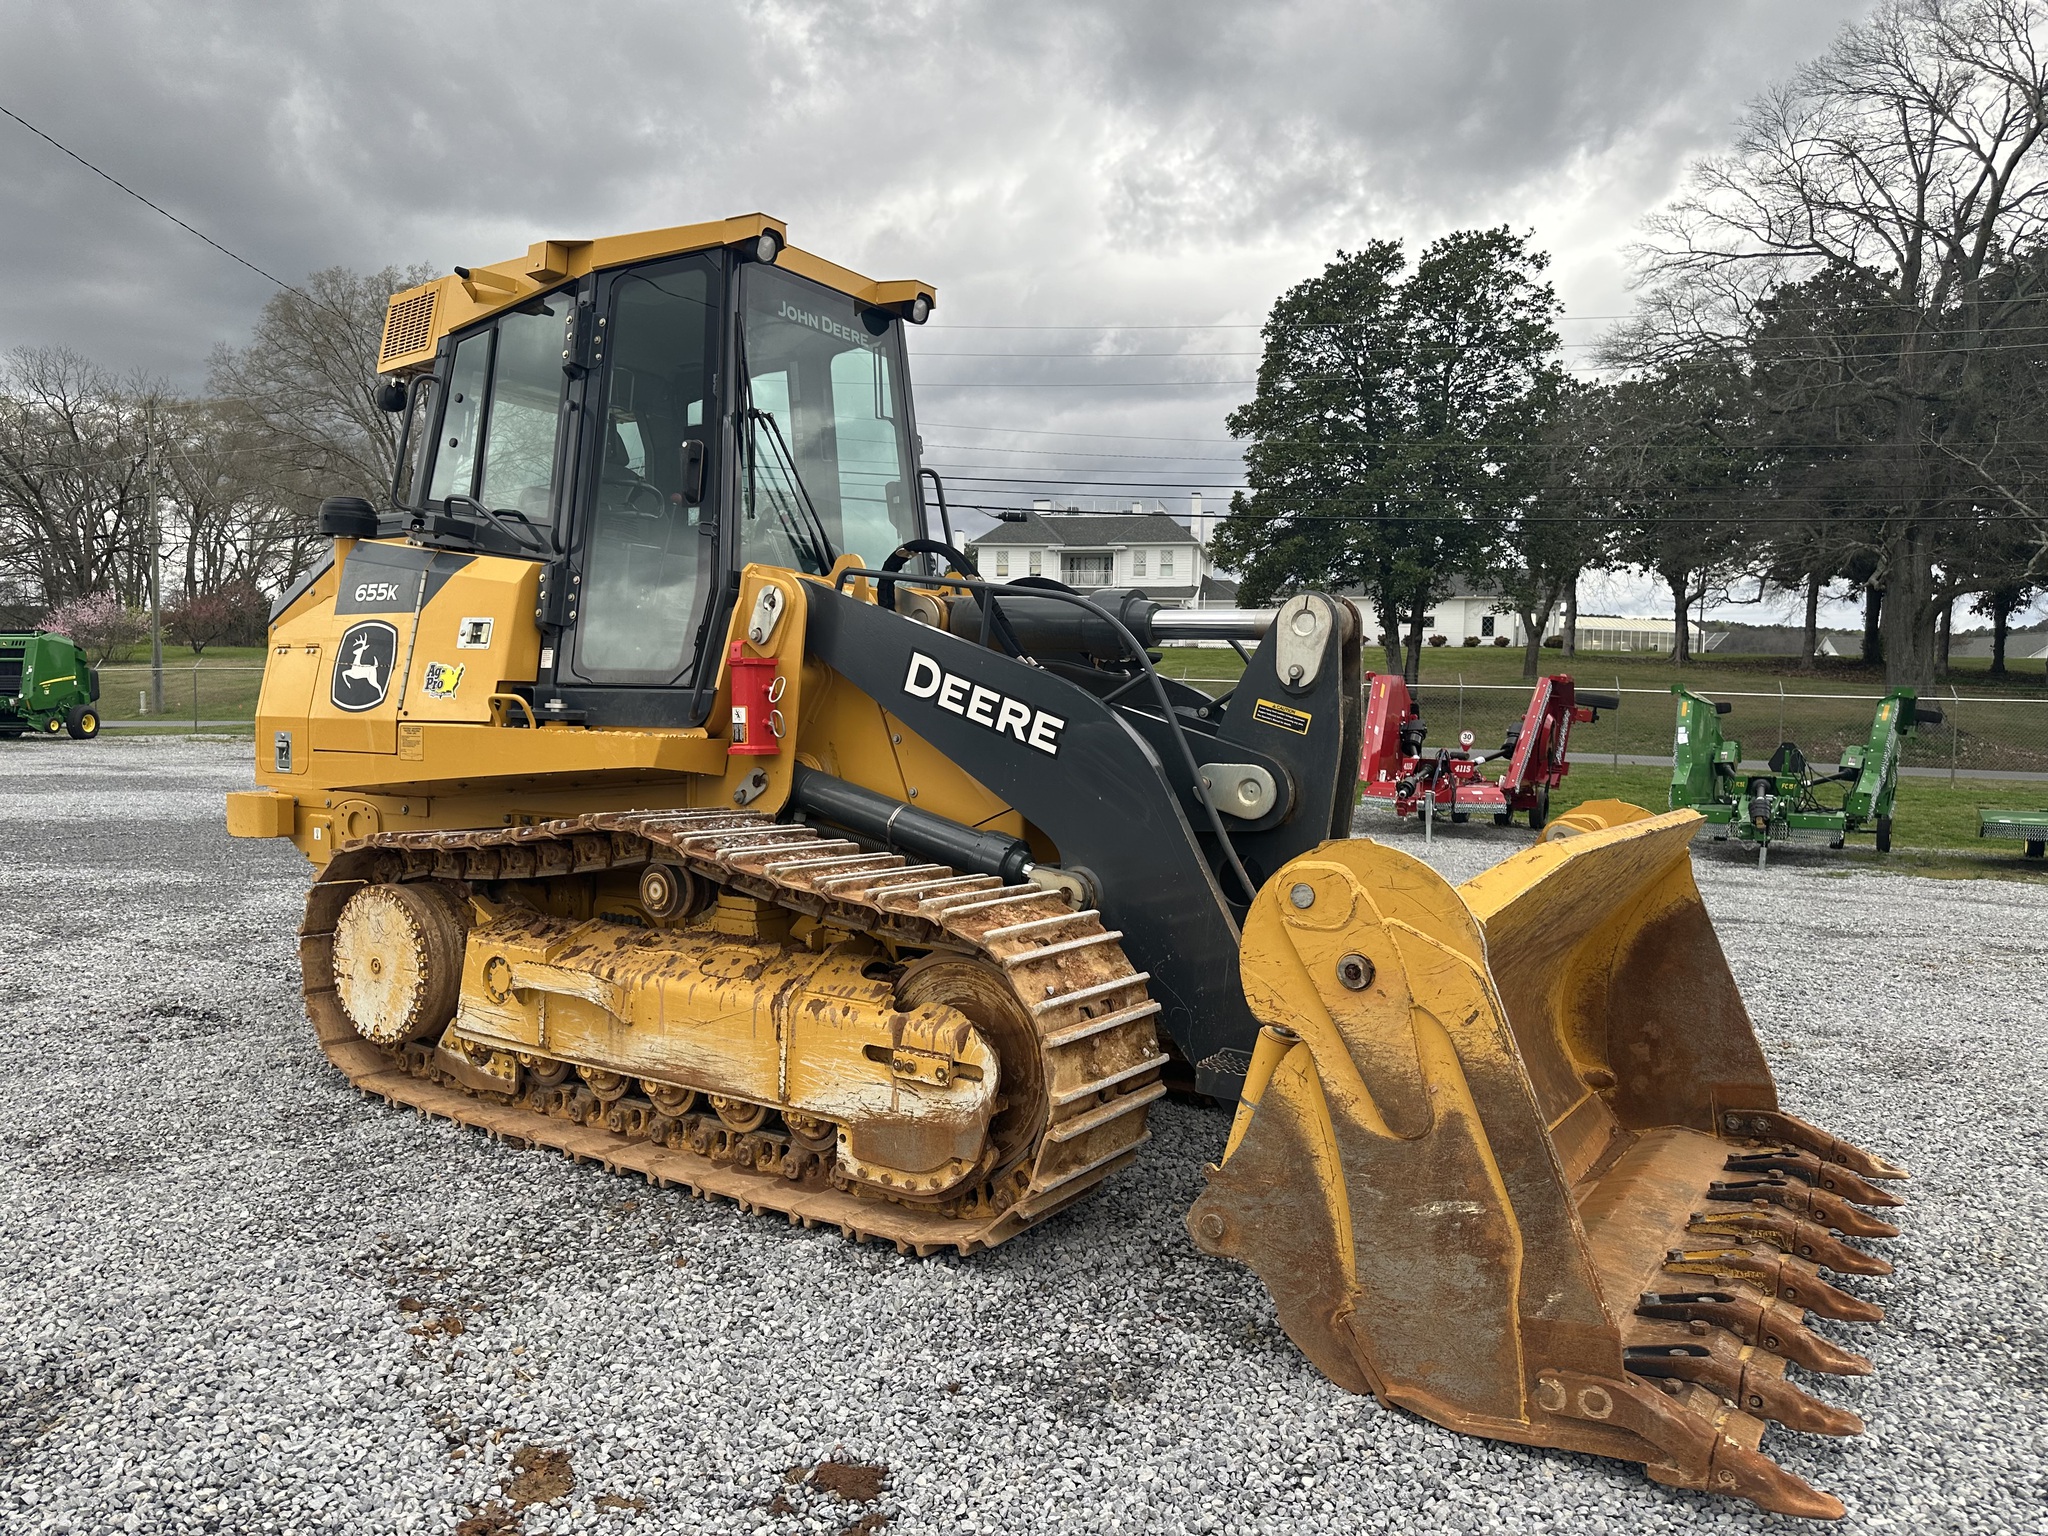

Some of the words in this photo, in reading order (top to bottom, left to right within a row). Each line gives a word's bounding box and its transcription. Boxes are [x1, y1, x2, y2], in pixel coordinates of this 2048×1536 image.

[778, 300, 819, 330] JOHN
[822, 315, 869, 348] DEERE
[354, 582, 399, 602] 655K
[425, 678, 444, 690] Pro
[903, 651, 1065, 755] DEERE
[1276, 704, 1297, 715] CAUTION
[1454, 764, 1472, 773] 4115
